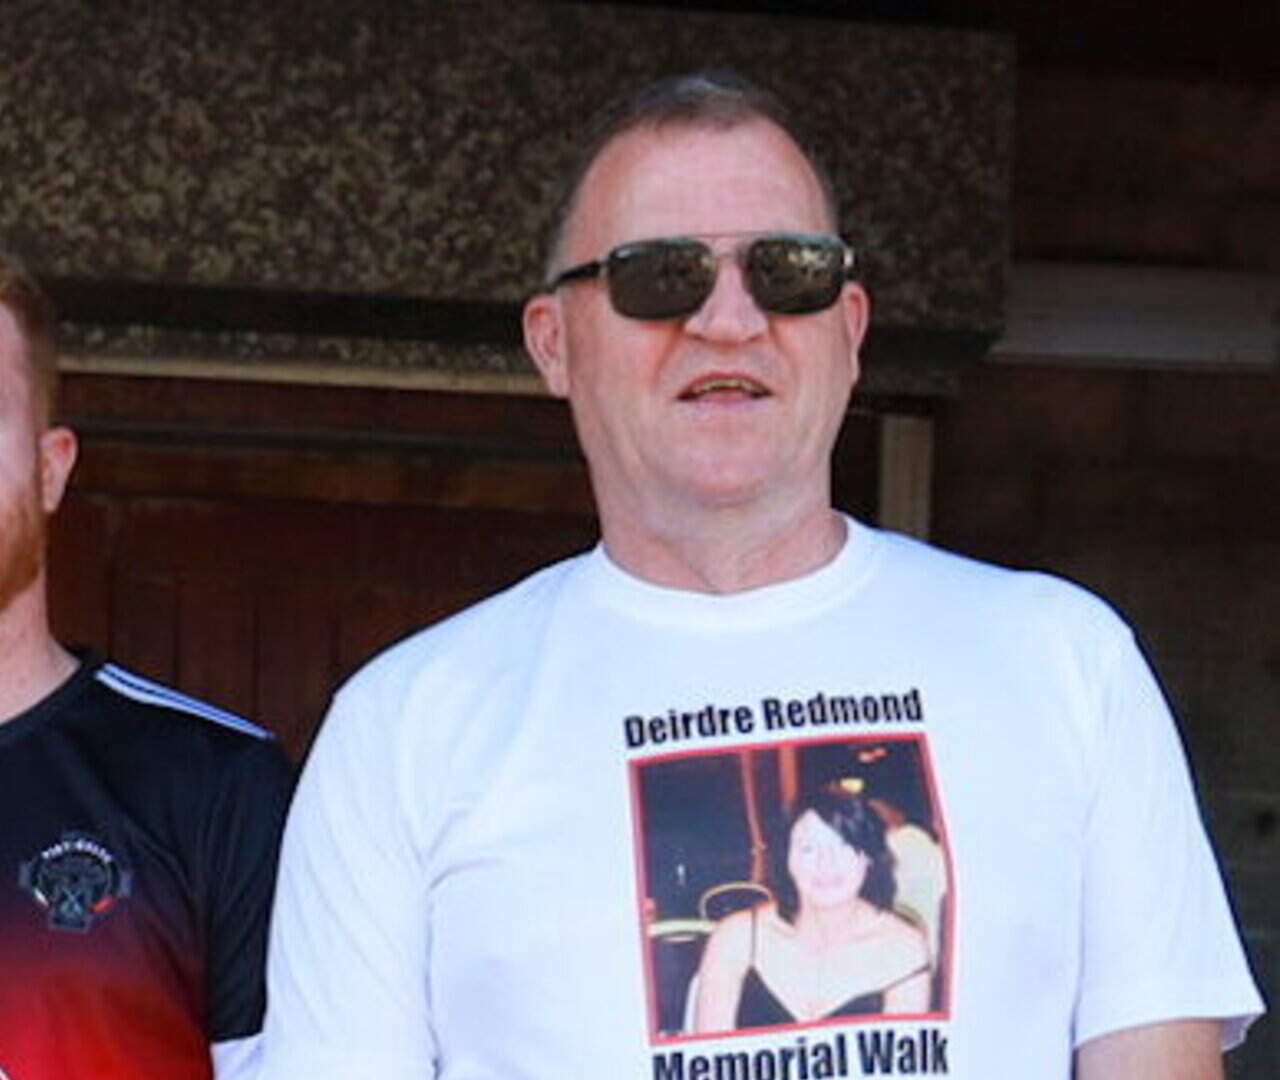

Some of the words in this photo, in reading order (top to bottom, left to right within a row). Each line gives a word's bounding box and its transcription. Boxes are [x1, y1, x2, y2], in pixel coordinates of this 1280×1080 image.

[623, 704, 754, 749] Deirdre
[762, 687, 925, 728] Redmond
[856, 1027, 949, 1076] Walk
